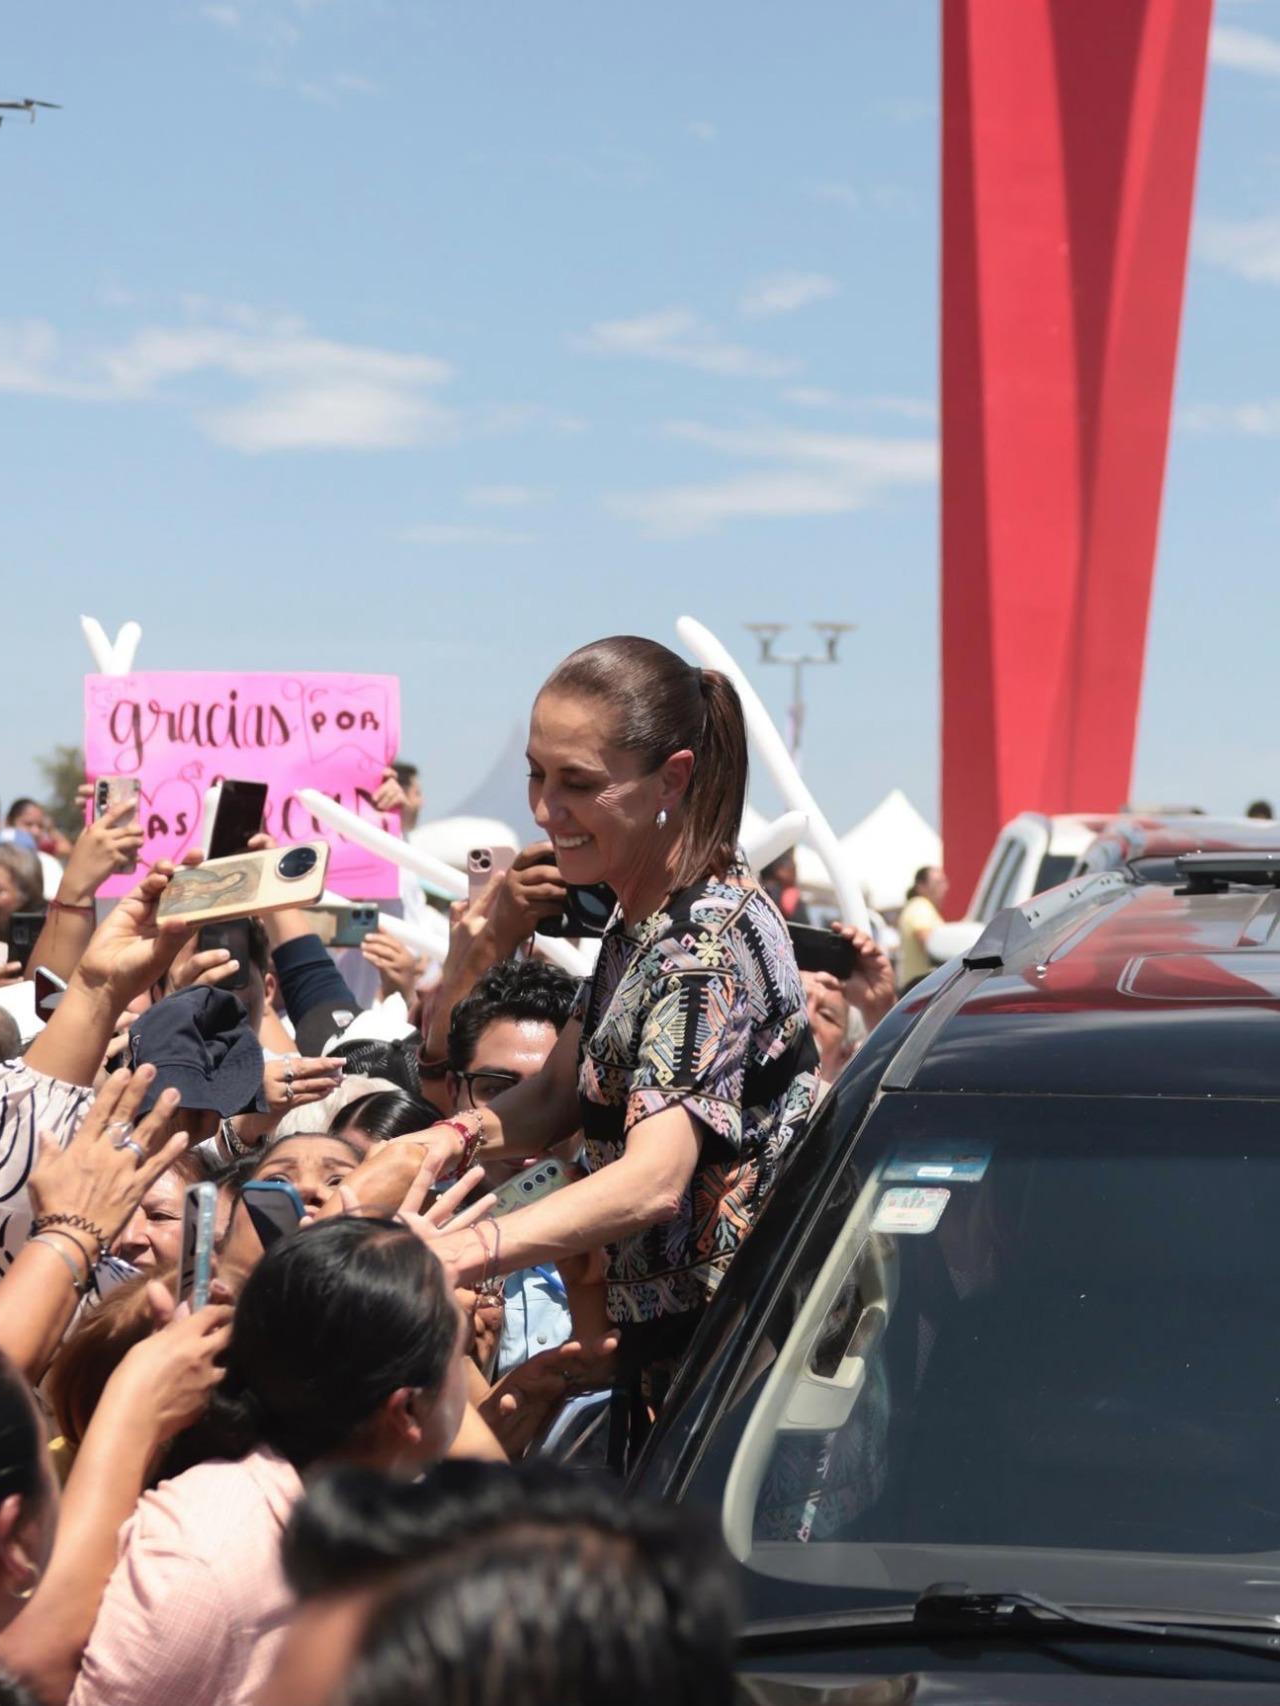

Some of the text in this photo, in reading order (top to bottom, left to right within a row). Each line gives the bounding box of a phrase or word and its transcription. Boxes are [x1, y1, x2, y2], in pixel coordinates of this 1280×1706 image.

[108, 689, 380, 773] gracias POR
[147, 812, 188, 839] AS
